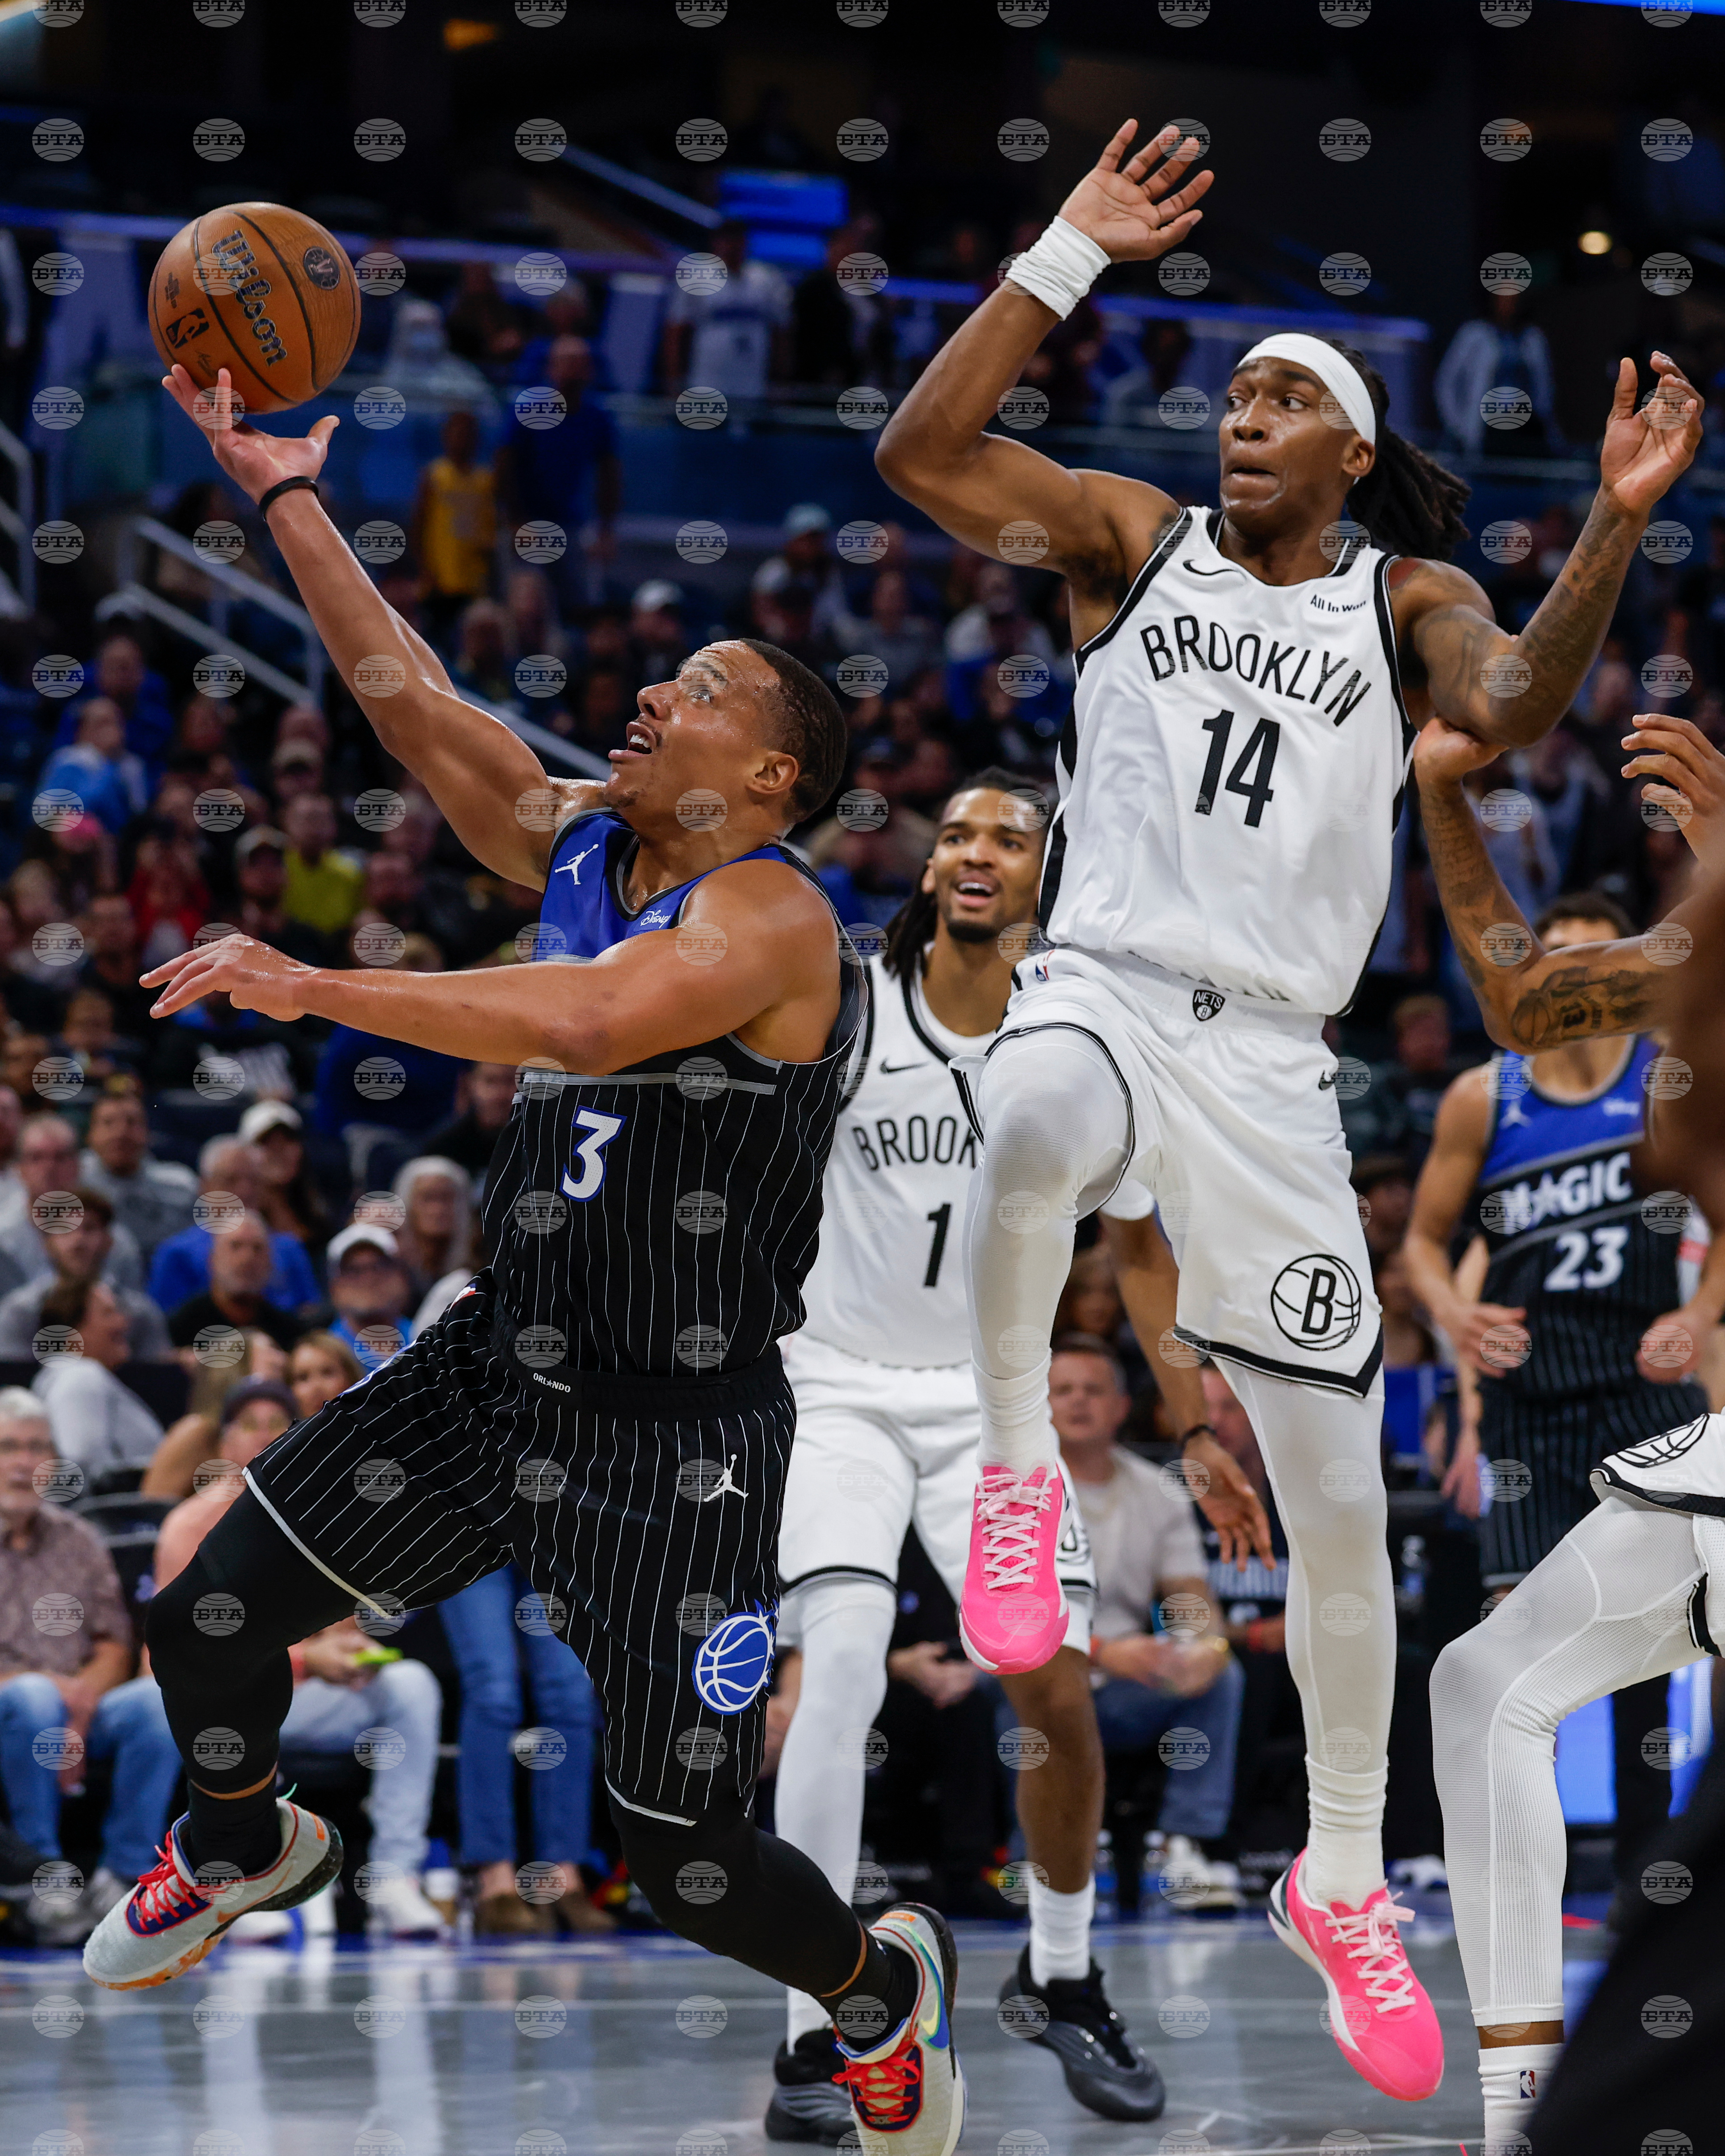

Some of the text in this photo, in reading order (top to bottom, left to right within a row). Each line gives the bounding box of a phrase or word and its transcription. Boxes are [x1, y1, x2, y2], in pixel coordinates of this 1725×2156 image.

[212, 227, 287, 367] Wilson
[1310, 594, 1325, 610] All
[1328, 601, 1339, 612] In
[1140, 616, 1372, 727] BROOKLYN
[1194, 709, 1281, 828] 14
[640, 910, 671, 929] Disney
[1194, 992, 1223, 1009] NETS
[559, 1105, 627, 1202] 3
[924, 1202, 952, 1289] 1
[1544, 1226, 1629, 1292] 23
[1301, 1268, 1336, 1335] B
